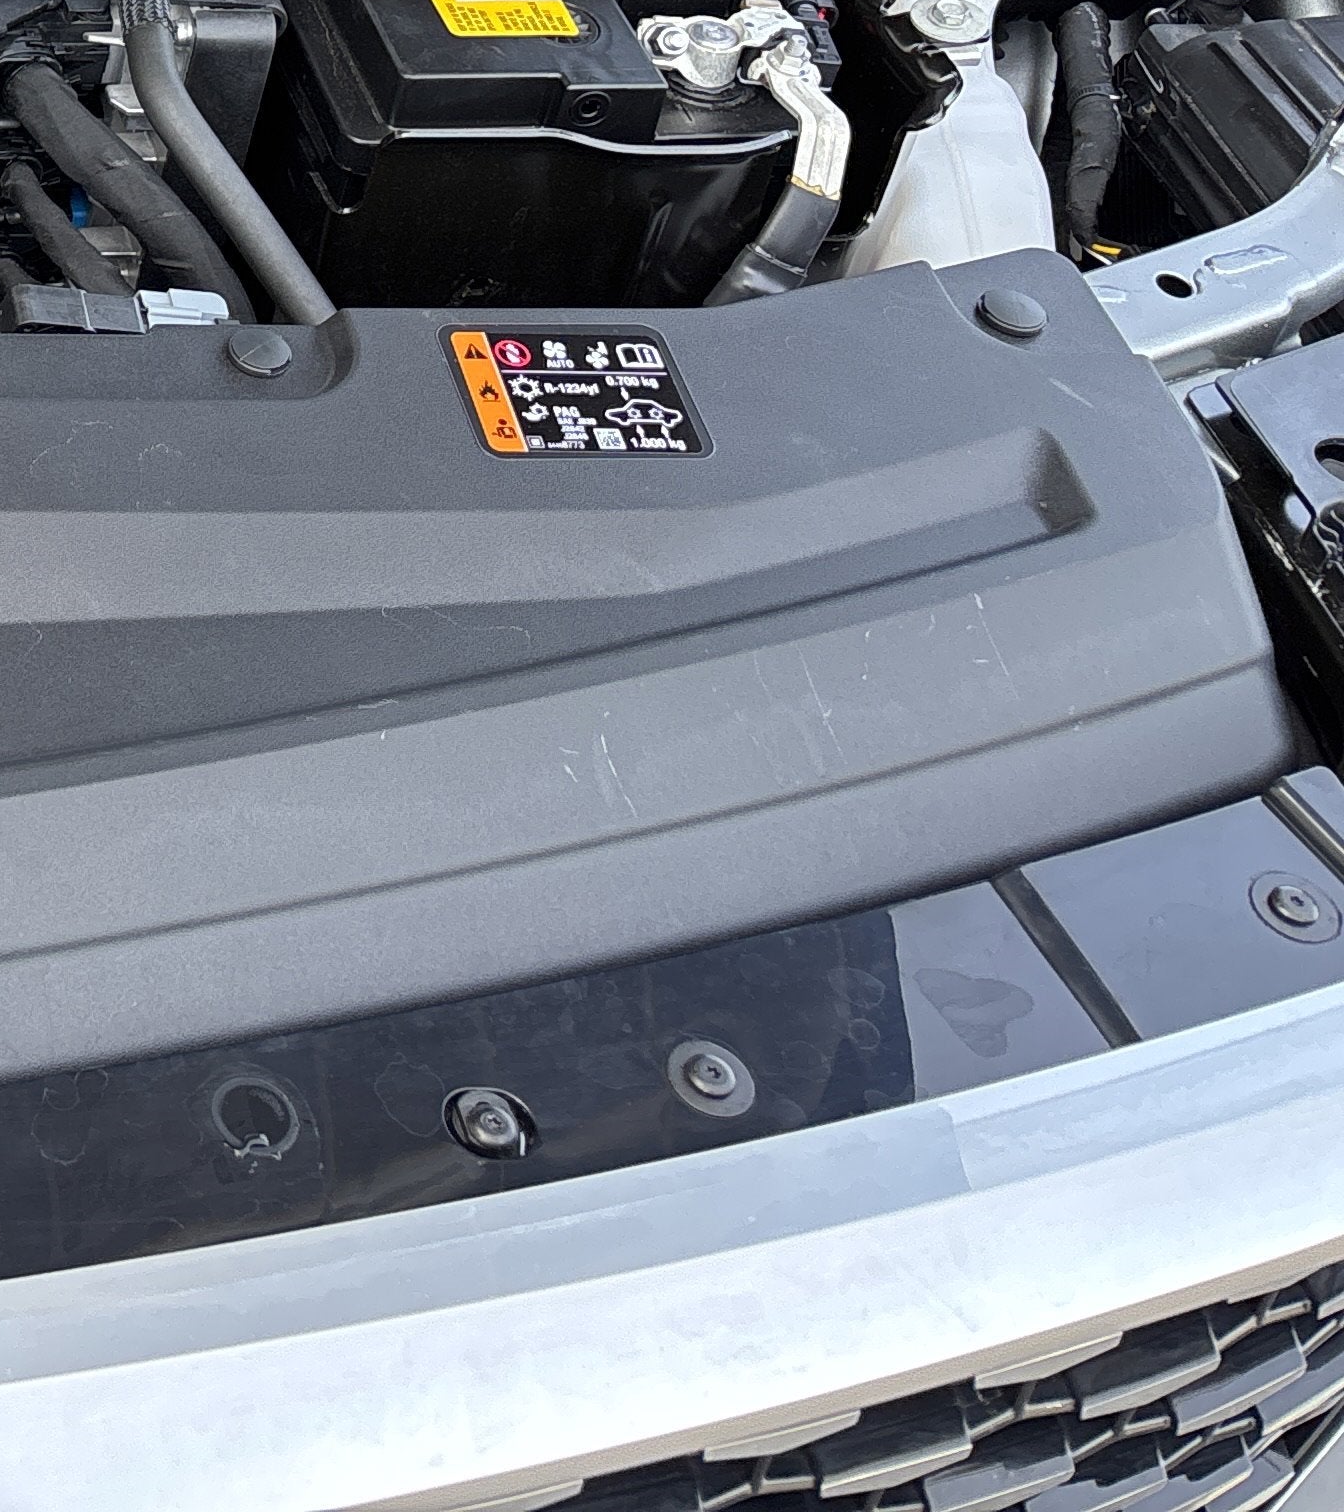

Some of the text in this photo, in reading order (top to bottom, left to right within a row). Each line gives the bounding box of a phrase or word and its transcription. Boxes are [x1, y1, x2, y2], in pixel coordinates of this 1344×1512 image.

[546, 359, 575, 369] AUTO
[543, 382, 600, 396] R-1234yf
[640, 376, 660, 390] kg
[667, 437, 687, 451] kg
